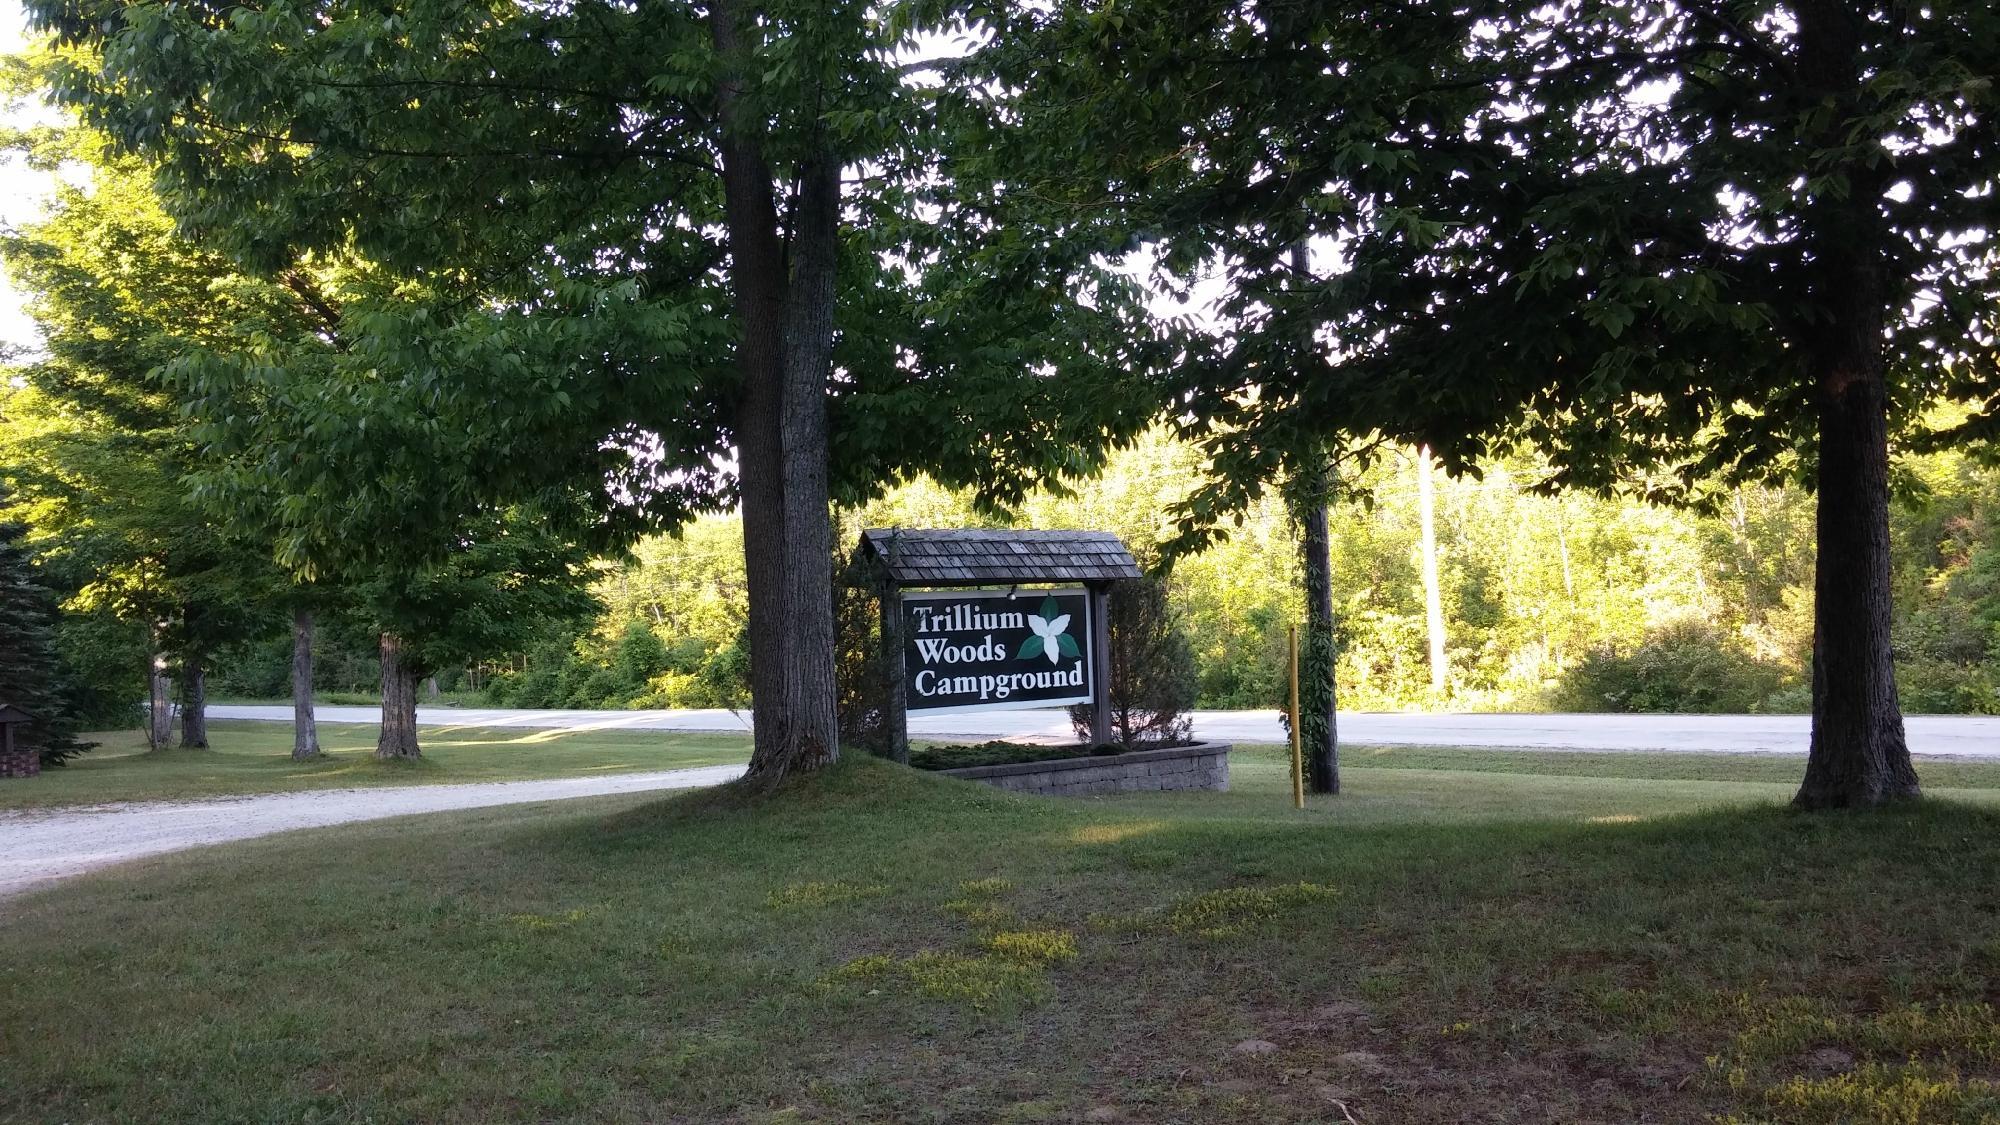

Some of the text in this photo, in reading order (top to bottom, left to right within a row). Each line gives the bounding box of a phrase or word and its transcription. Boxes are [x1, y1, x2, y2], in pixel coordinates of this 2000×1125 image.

[913, 604, 1024, 633] Trillium
[914, 634, 1006, 664] Woods
[915, 660, 1084, 700] Campground
